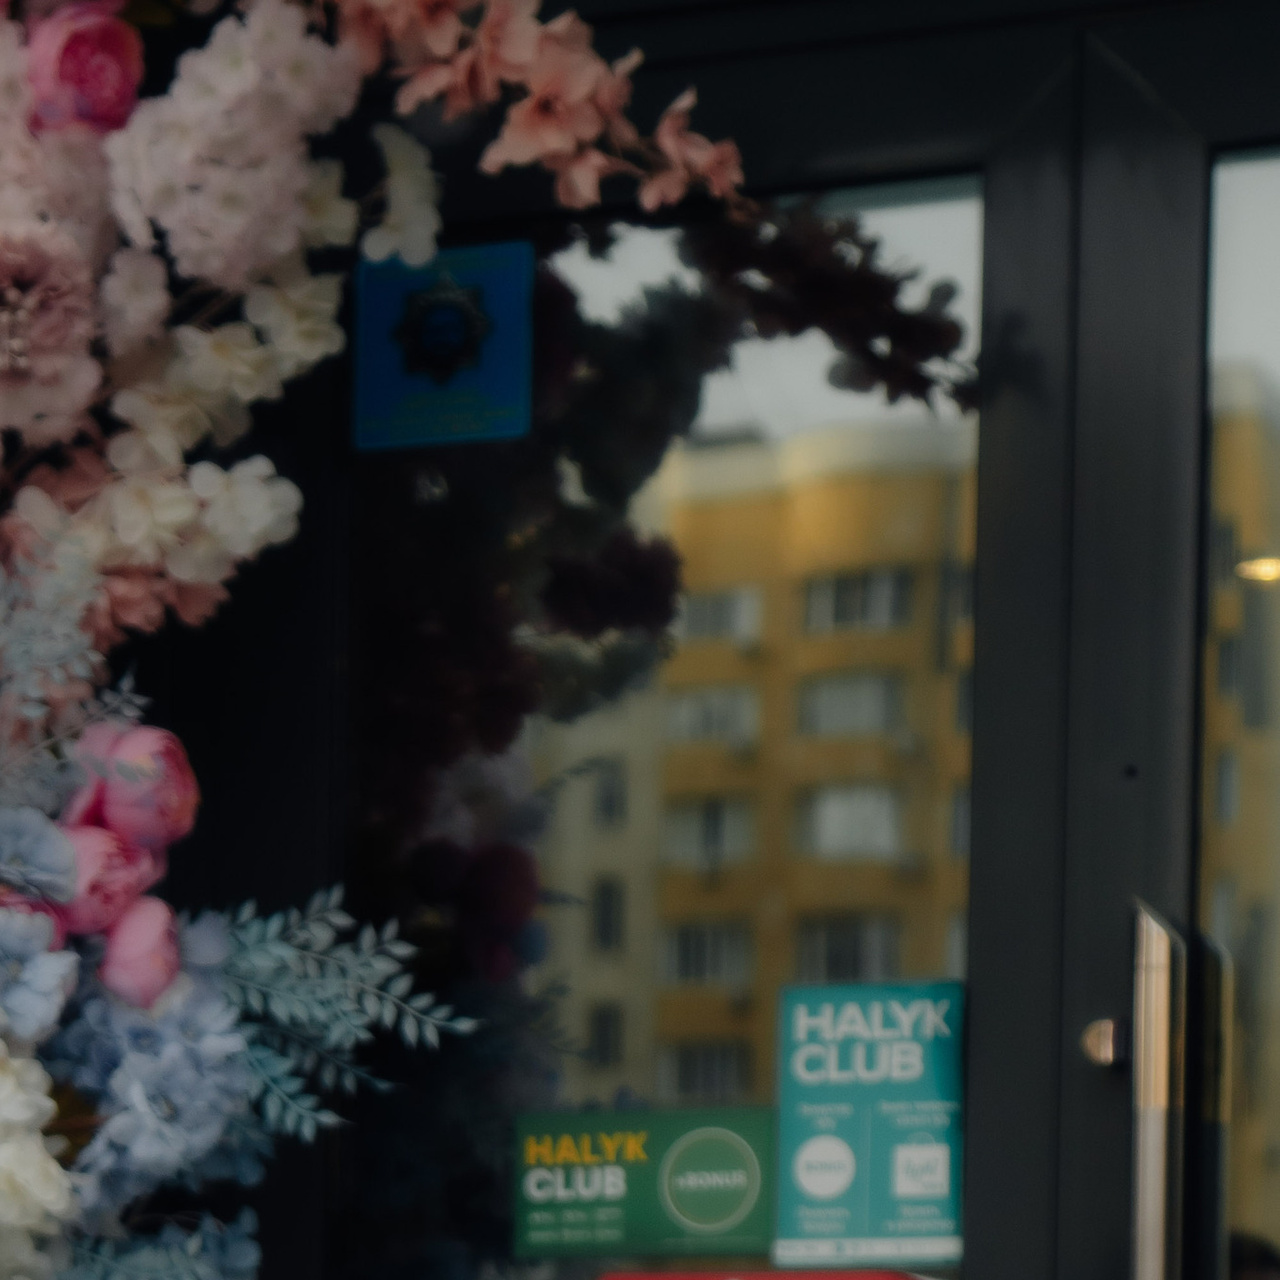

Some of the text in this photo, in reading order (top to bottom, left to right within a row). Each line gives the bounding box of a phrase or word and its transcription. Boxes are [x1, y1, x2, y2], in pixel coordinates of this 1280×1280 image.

[793, 999, 951, 1042] HALYK
[792, 1041, 925, 1086] CLUB
[524, 1129, 649, 1166] HALYK
[523, 1165, 627, 1203] CLUB
